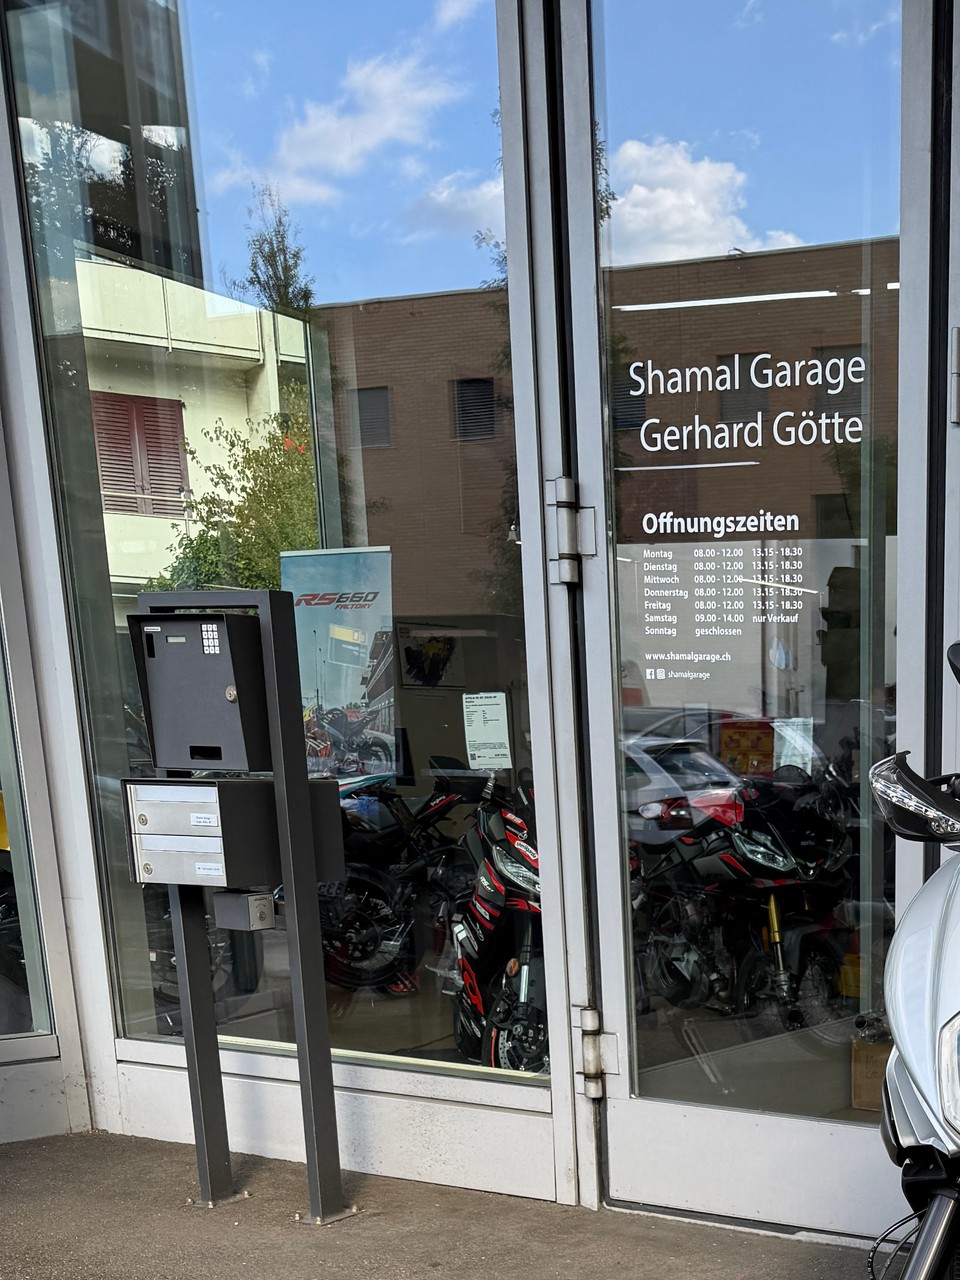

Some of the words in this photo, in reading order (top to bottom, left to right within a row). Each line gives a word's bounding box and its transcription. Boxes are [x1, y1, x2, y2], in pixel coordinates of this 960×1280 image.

[629, 354, 740, 396] Shamal
[750, 354, 865, 394] Garage
[640, 411, 762, 451] Gerhard
[773, 411, 863, 446] Götte
[643, 549, 672, 559] Montag
[694, 549, 715, 557] 08.00
[722, 549, 743, 557] 12.00
[752, 548, 773, 556] 13.15
[781, 548, 802, 556] 18.30
[643, 562, 677, 572] Dienstag
[694, 562, 715, 570] 08.00
[722, 562, 743, 570] 12.00
[752, 561, 773, 570] 13.15
[781, 561, 802, 569] 18.30
[644, 575, 679, 584] Mittwoch
[694, 575, 716, 583] 08.00
[722, 575, 743, 583] 12.00
[781, 574, 802, 583] 18.30
[644, 588, 688, 598] Donnerstag
[694, 588, 716, 596] 08.00
[723, 588, 744, 596] 12.00
[752, 588, 773, 596] 13.15
[644, 601, 671, 611] Freitag
[695, 601, 716, 609] 08.00
[723, 601, 744, 609] 12.00
[753, 601, 774, 609] 13.15
[781, 601, 803, 609] 18.30
[645, 614, 677, 624] Samstag
[695, 614, 717, 622] 09.00
[723, 614, 744, 622] 14.00
[767, 613, 799, 623] Verkauf
[645, 627, 677, 637] Sonntag
[695, 626, 742, 637] geschlossen
[645, 652, 731, 662] www.shamalgarage.ch
[668, 671, 710, 679] shamalgarage
